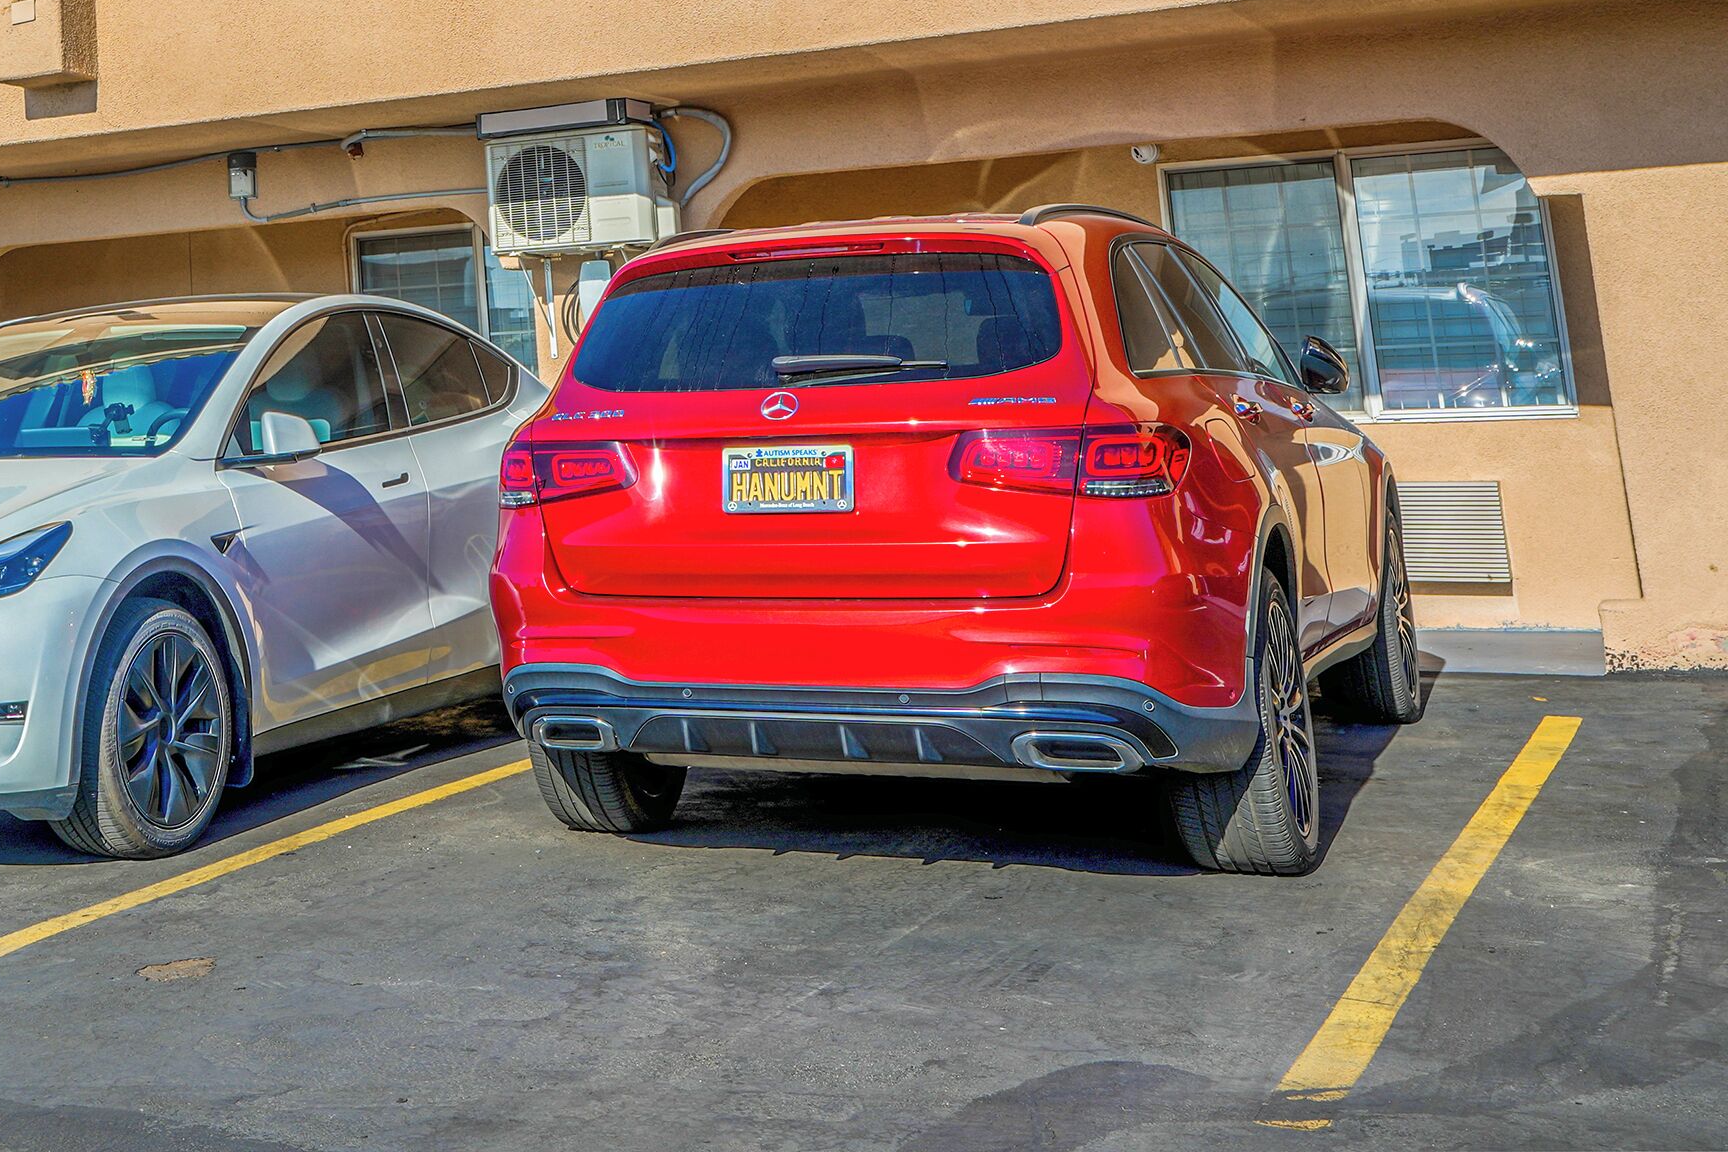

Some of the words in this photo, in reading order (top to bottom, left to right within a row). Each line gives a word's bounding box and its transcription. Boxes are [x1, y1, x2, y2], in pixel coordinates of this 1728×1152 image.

[552, 411, 586, 421] GLC
[764, 449, 791, 457] AUTISM
[733, 460, 749, 469] JAN
[755, 457, 823, 468] CALIFORNIA
[732, 469, 843, 502] HANUMNT
